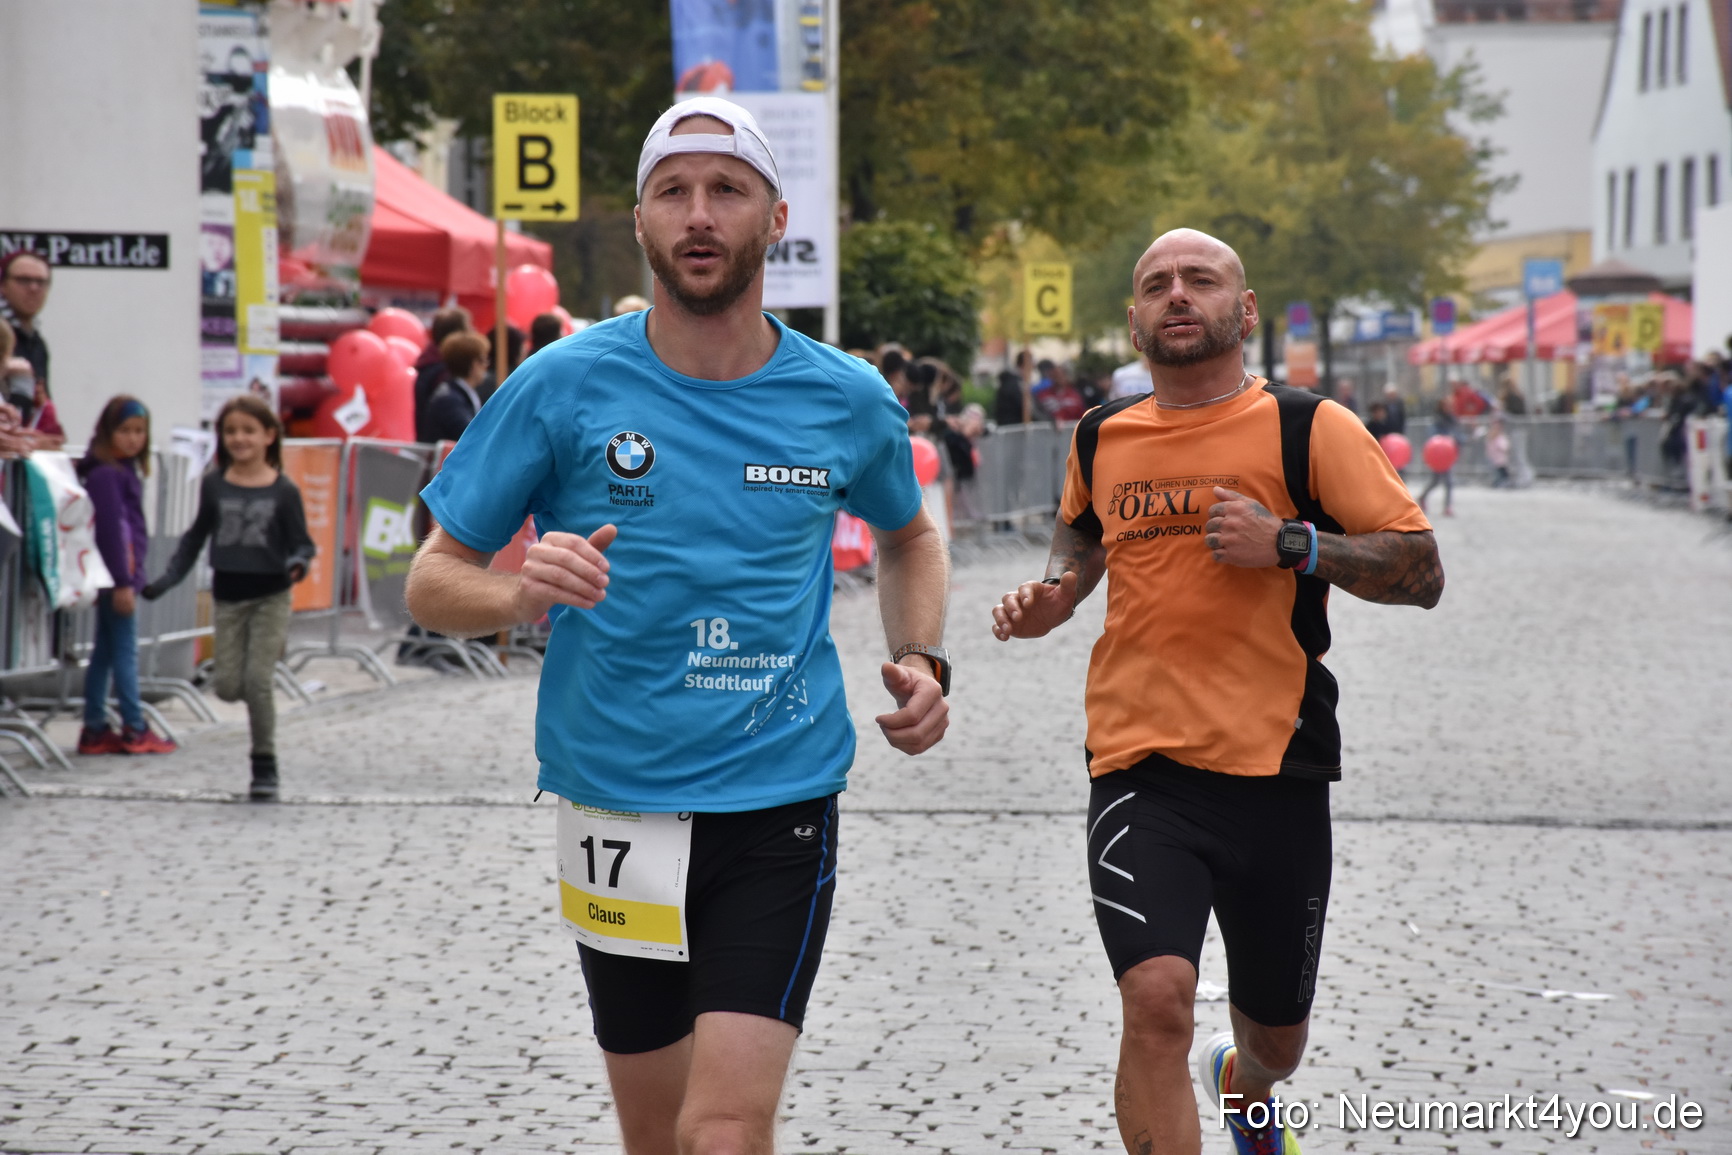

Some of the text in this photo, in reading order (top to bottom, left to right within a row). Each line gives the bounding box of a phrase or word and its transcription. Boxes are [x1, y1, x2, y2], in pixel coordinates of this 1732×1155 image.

[505, 101, 567, 122] Block
[517, 134, 556, 191] B
[1036, 284, 1059, 318] C
[611, 433, 651, 449] BMW
[745, 465, 828, 487] BOCK
[1155, 480, 1180, 490] UHREN
[1199, 478, 1239, 486] SCHMUCK
[608, 484, 655, 498] PARTL
[774, 486, 784, 494] by
[609, 495, 655, 507] Neumarkt
[690, 617, 739, 650] 18.
[687, 651, 796, 669] Neumarkter
[684, 673, 775, 694] Stadtlauf
[580, 835, 631, 888] 17
[588, 902, 626, 926] Claus
